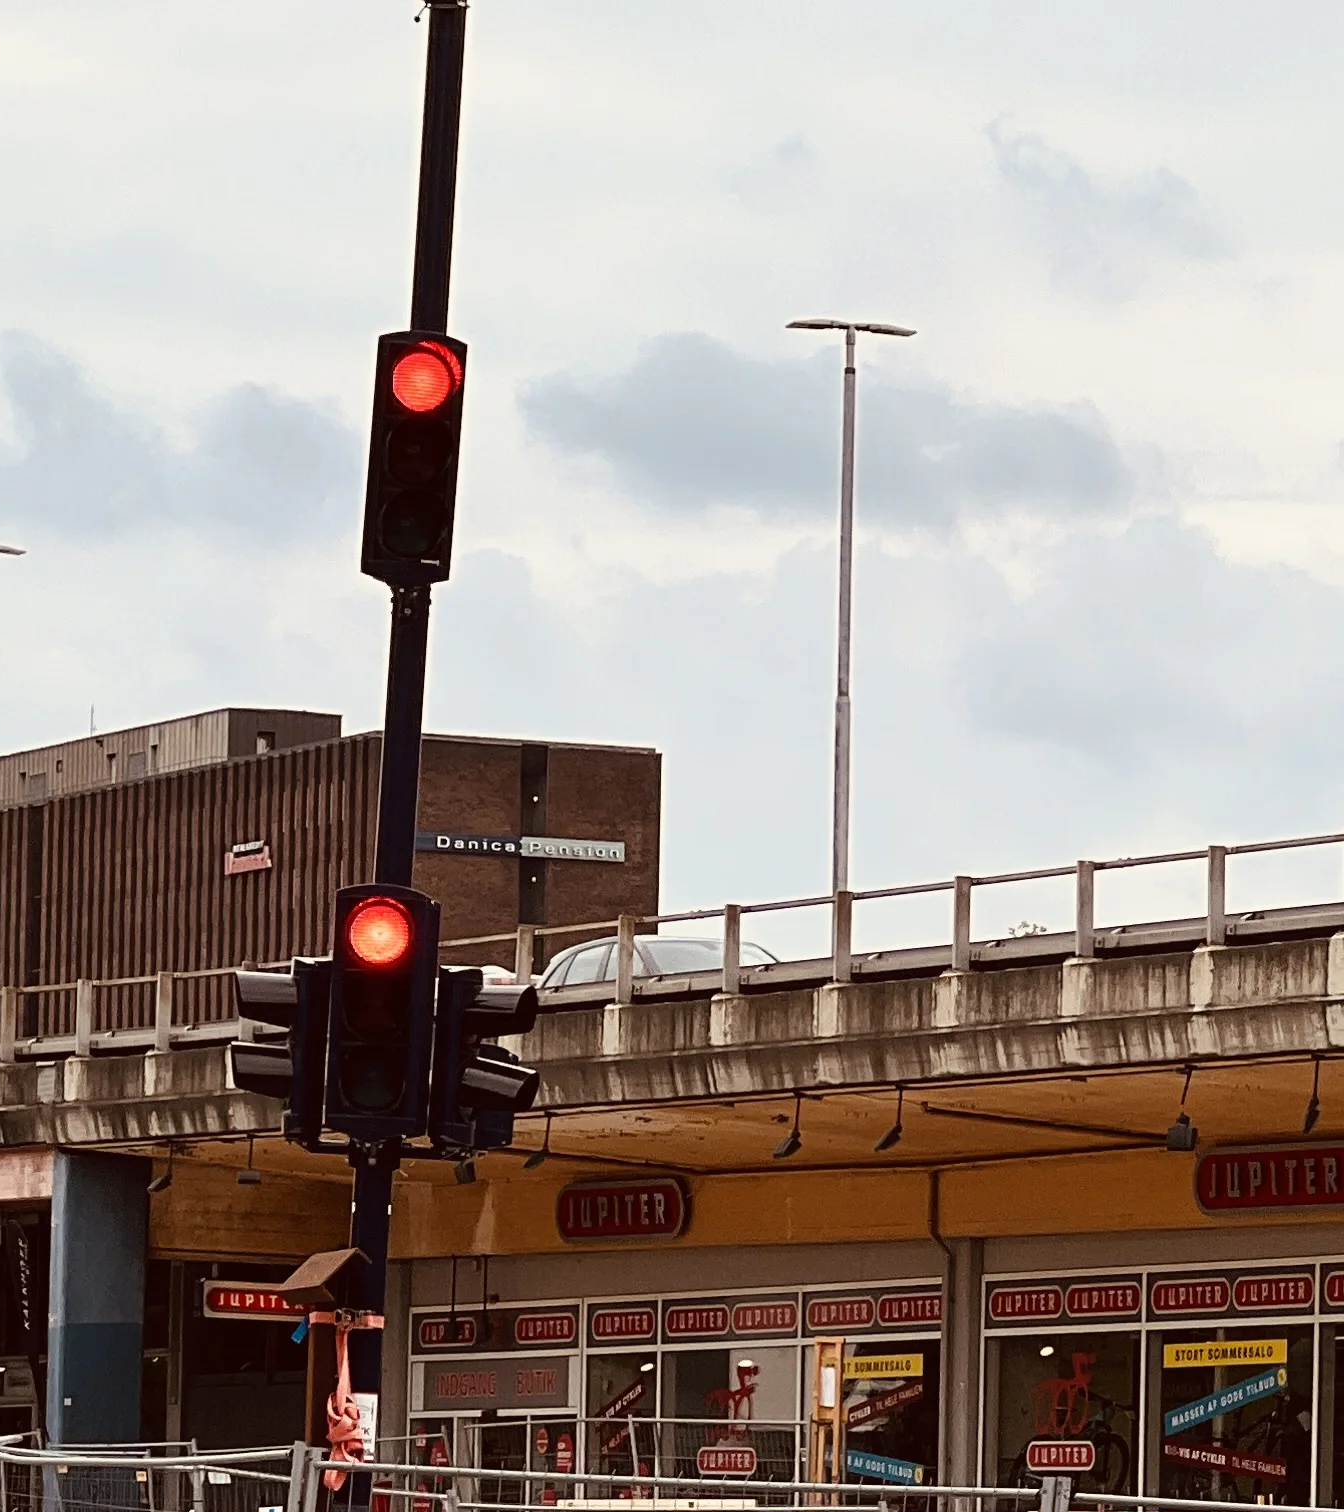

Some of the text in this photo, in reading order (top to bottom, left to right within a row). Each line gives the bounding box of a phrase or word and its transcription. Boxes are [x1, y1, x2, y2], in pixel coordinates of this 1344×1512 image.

[436, 835, 620, 859] Danica Pension
[1209, 1157, 1338, 1199] JUPITER
[567, 1193, 665, 1229] JUPITER
[1073, 1289, 1133, 1309] JUPITER
[1160, 1286, 1222, 1306] JUPITER
[1242, 1281, 1305, 1303] JUPITER
[814, 1303, 868, 1323] JUPITER
[884, 1299, 940, 1319] JUPITER
[997, 1293, 1055, 1313] JUPITER
[599, 1314, 649, 1333] JUPITER
[672, 1311, 723, 1329] JUPITER
[738, 1307, 791, 1326] JUPITER
[521, 1319, 569, 1337] JUPITER
[1175, 1345, 1274, 1362] STORT SOMMERSALG
[855, 1360, 911, 1373] SOMMERSALG
[435, 1368, 556, 1398] INDGANG BUTIK
[1172, 1375, 1275, 1427] MASSER AF GODE TILBUD
[703, 1452, 750, 1469] JUPITER
[1034, 1447, 1088, 1464] JUPITER
[1201, 1451, 1226, 1466] CYKLER
[1258, 1461, 1287, 1477] FAMILIEN
[865, 1460, 886, 1474] GODE
[887, 1463, 913, 1479] TILBUD
